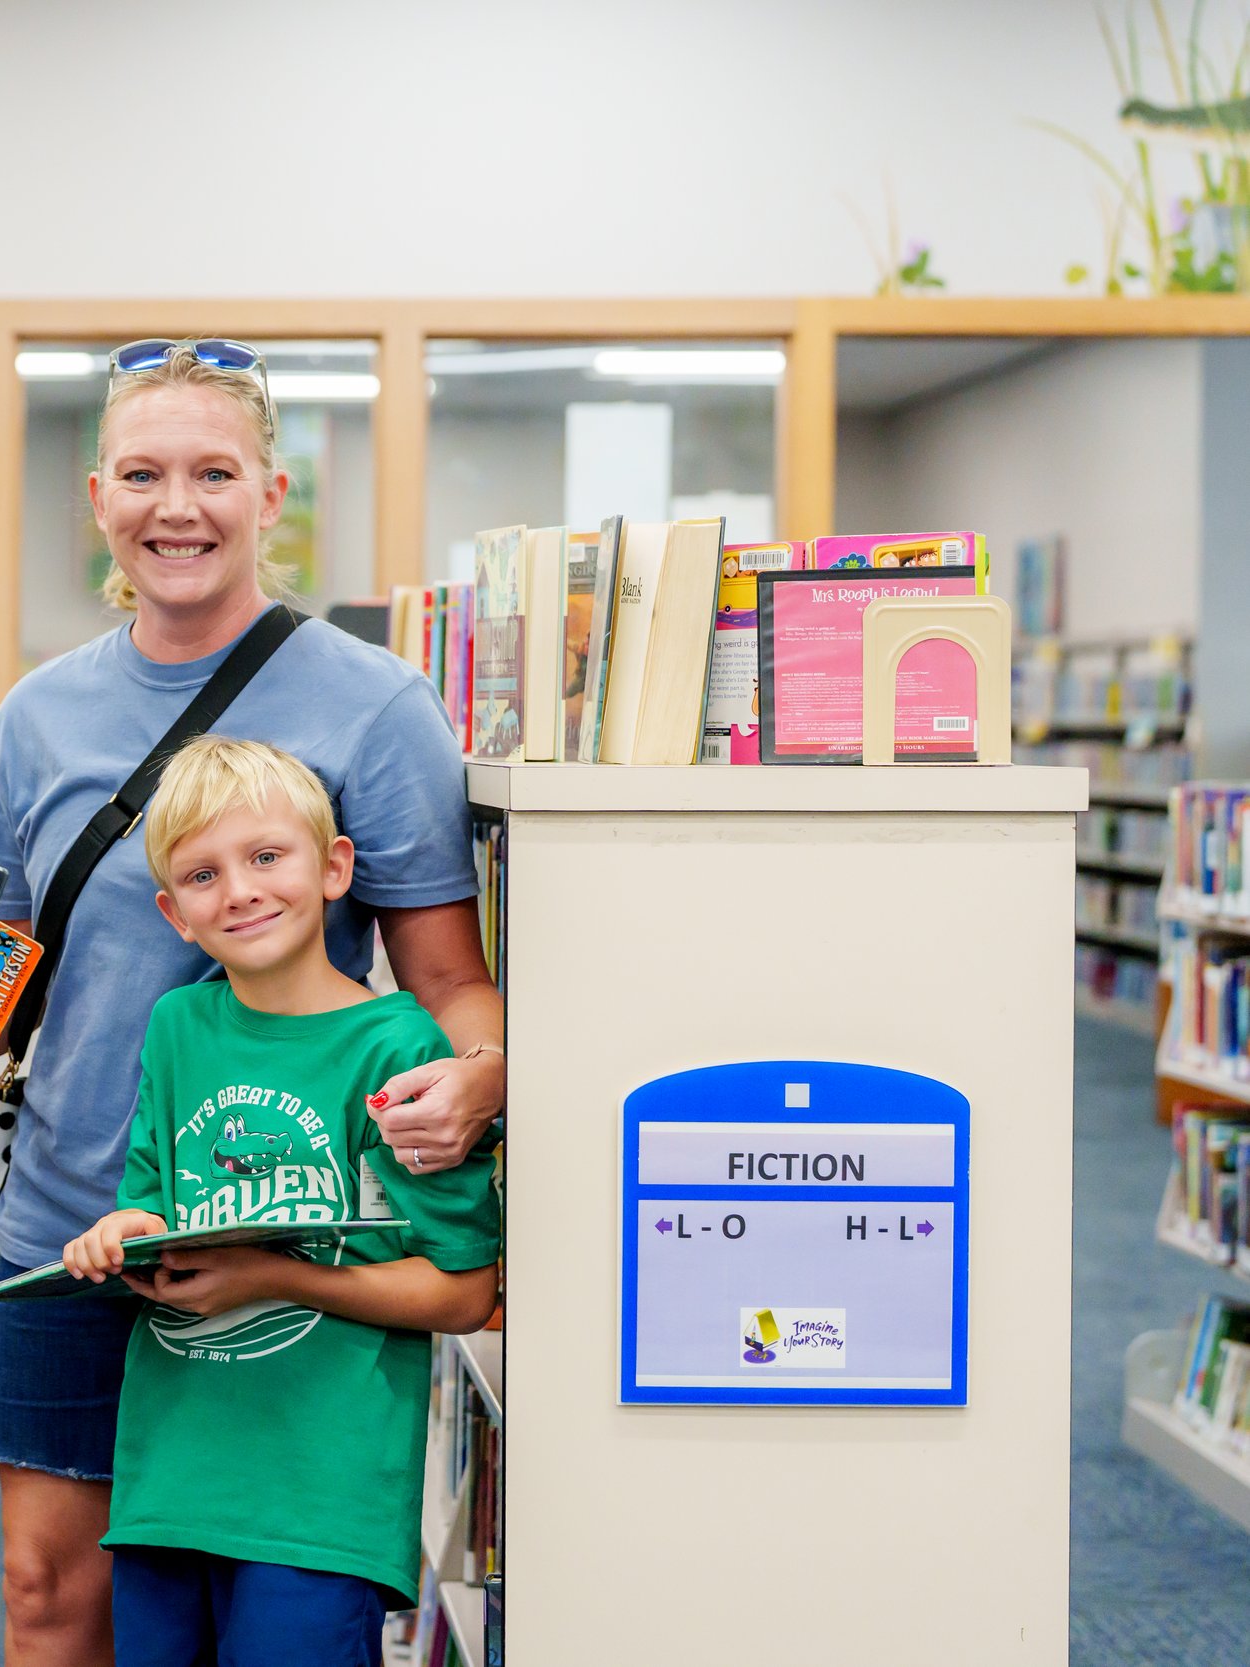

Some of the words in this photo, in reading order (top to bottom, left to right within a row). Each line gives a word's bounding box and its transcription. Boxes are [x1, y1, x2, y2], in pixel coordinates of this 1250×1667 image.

[812, 588, 836, 604] Mrs.
[838, 587, 878, 604] Roopy
[723, 638, 741, 648] weird
[186, 1101, 216, 1137] IT'S
[217, 1084, 276, 1110] GREAT
[276, 1091, 302, 1116] TO
[296, 1107, 322, 1135] BE
[312, 1133, 330, 1151] A
[728, 1152, 865, 1182] FICTION
[678, 1214, 692, 1239] L
[722, 1214, 746, 1240] O
[846, 1216, 868, 1240] H
[900, 1216, 914, 1240] L
[811, 1333, 844, 1351] STORY
[188, 1349, 206, 1360] EST.
[208, 1350, 231, 1363] 1974
